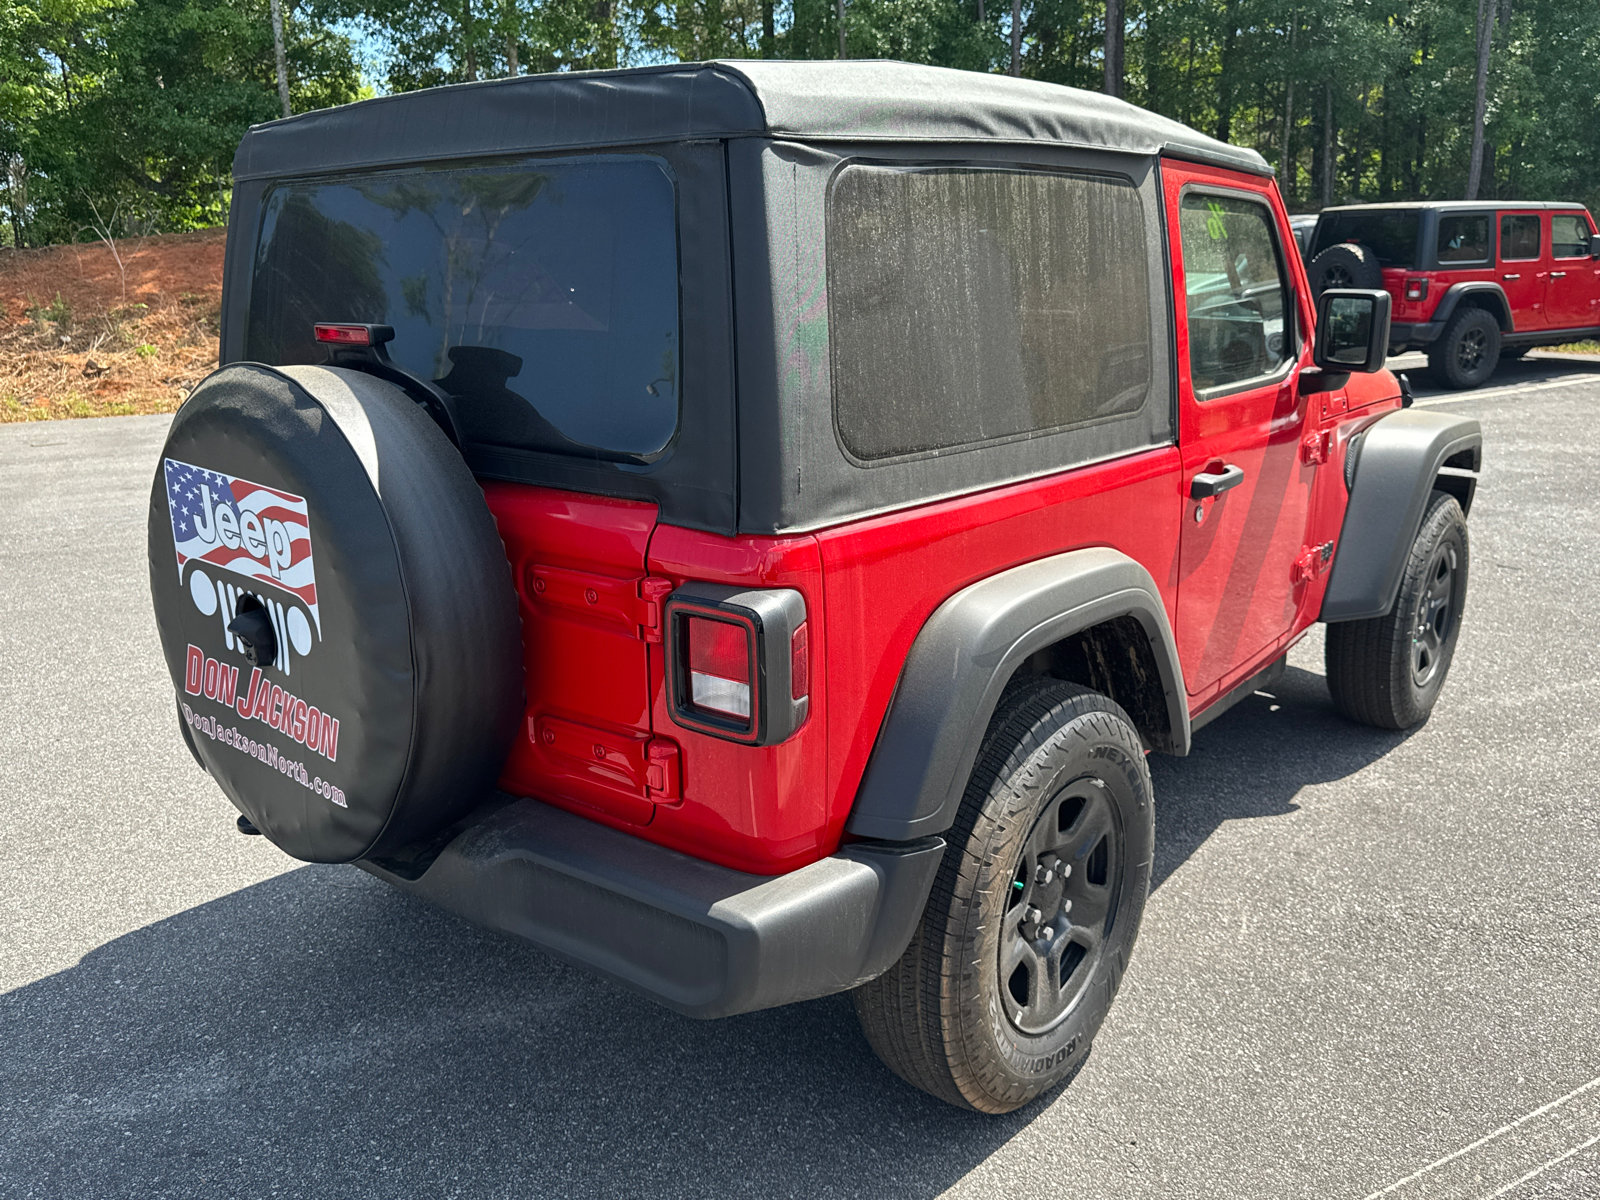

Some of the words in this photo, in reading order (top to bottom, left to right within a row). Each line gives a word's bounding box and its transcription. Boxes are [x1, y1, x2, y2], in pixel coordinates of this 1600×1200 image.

[192, 483, 292, 580] Jeep
[182, 702, 348, 809] DonJacksonNorth.com
[185, 643, 239, 708] DON
[236, 666, 340, 762] JACKSON
